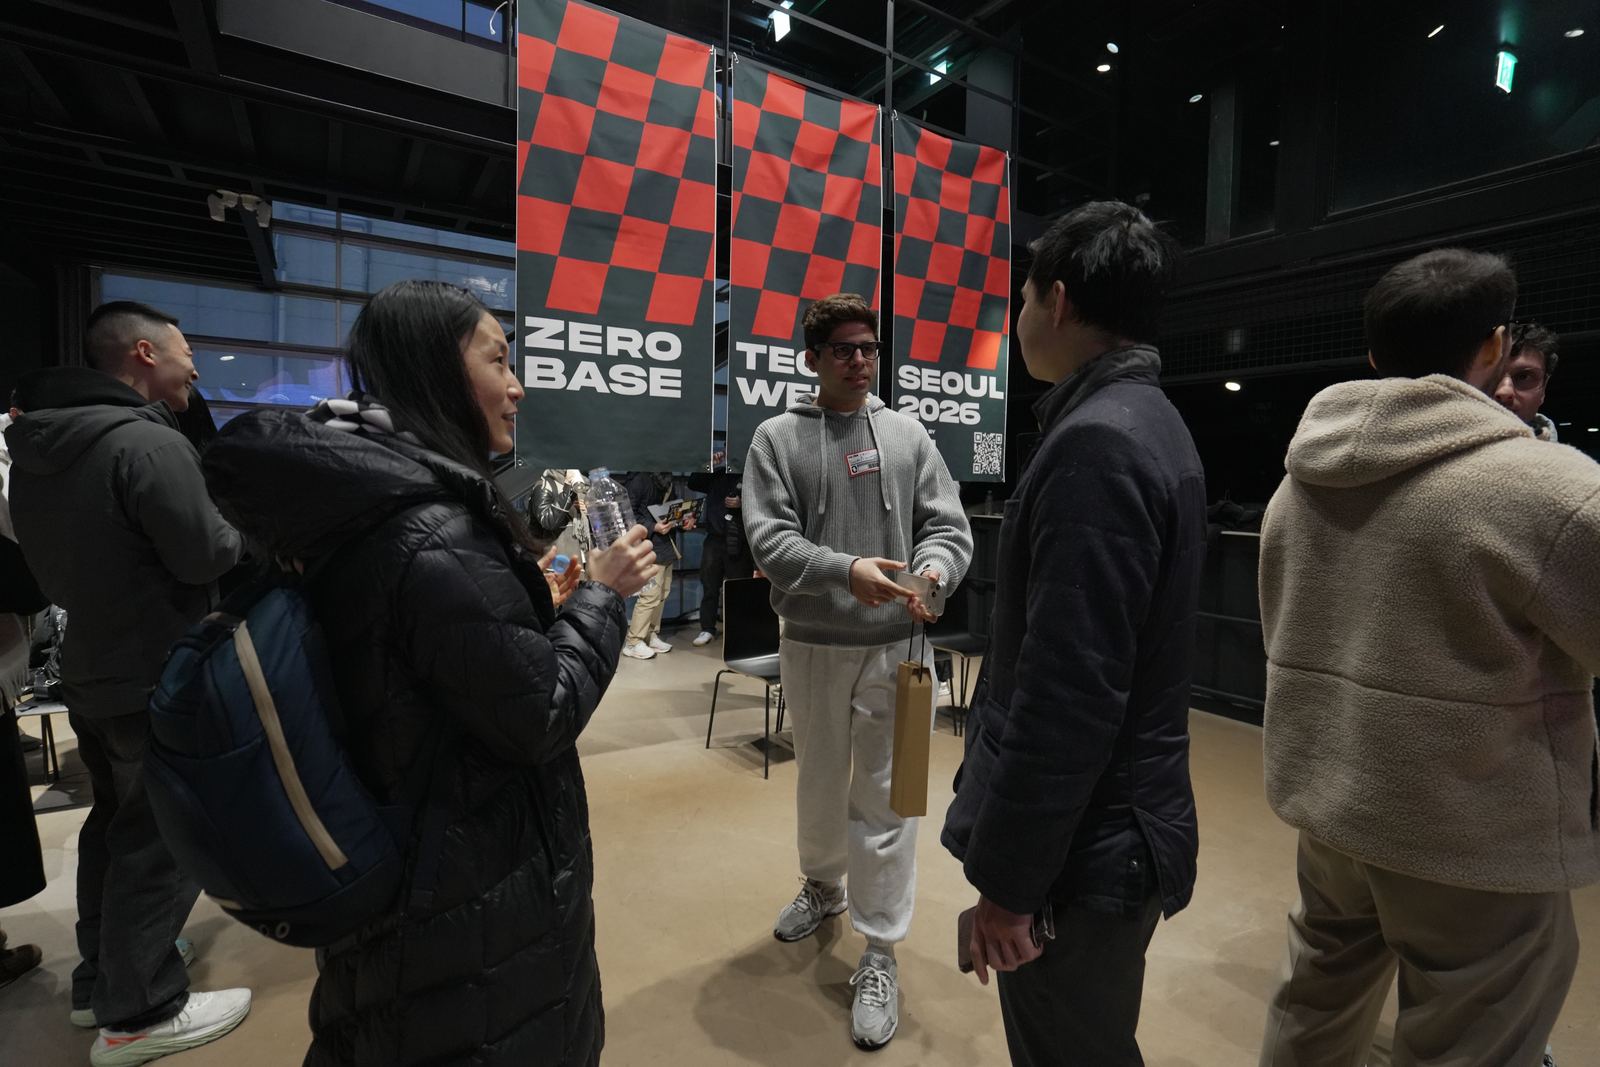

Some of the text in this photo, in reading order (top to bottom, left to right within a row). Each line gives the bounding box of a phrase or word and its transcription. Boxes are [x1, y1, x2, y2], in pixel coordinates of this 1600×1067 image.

[525, 316, 682, 361] ZERO
[736, 341, 819, 377] TEC
[525, 355, 682, 399] BASE
[736, 376, 820, 408] WE
[898, 364, 1004, 399] SEOUL
[898, 394, 981, 425] 2026
